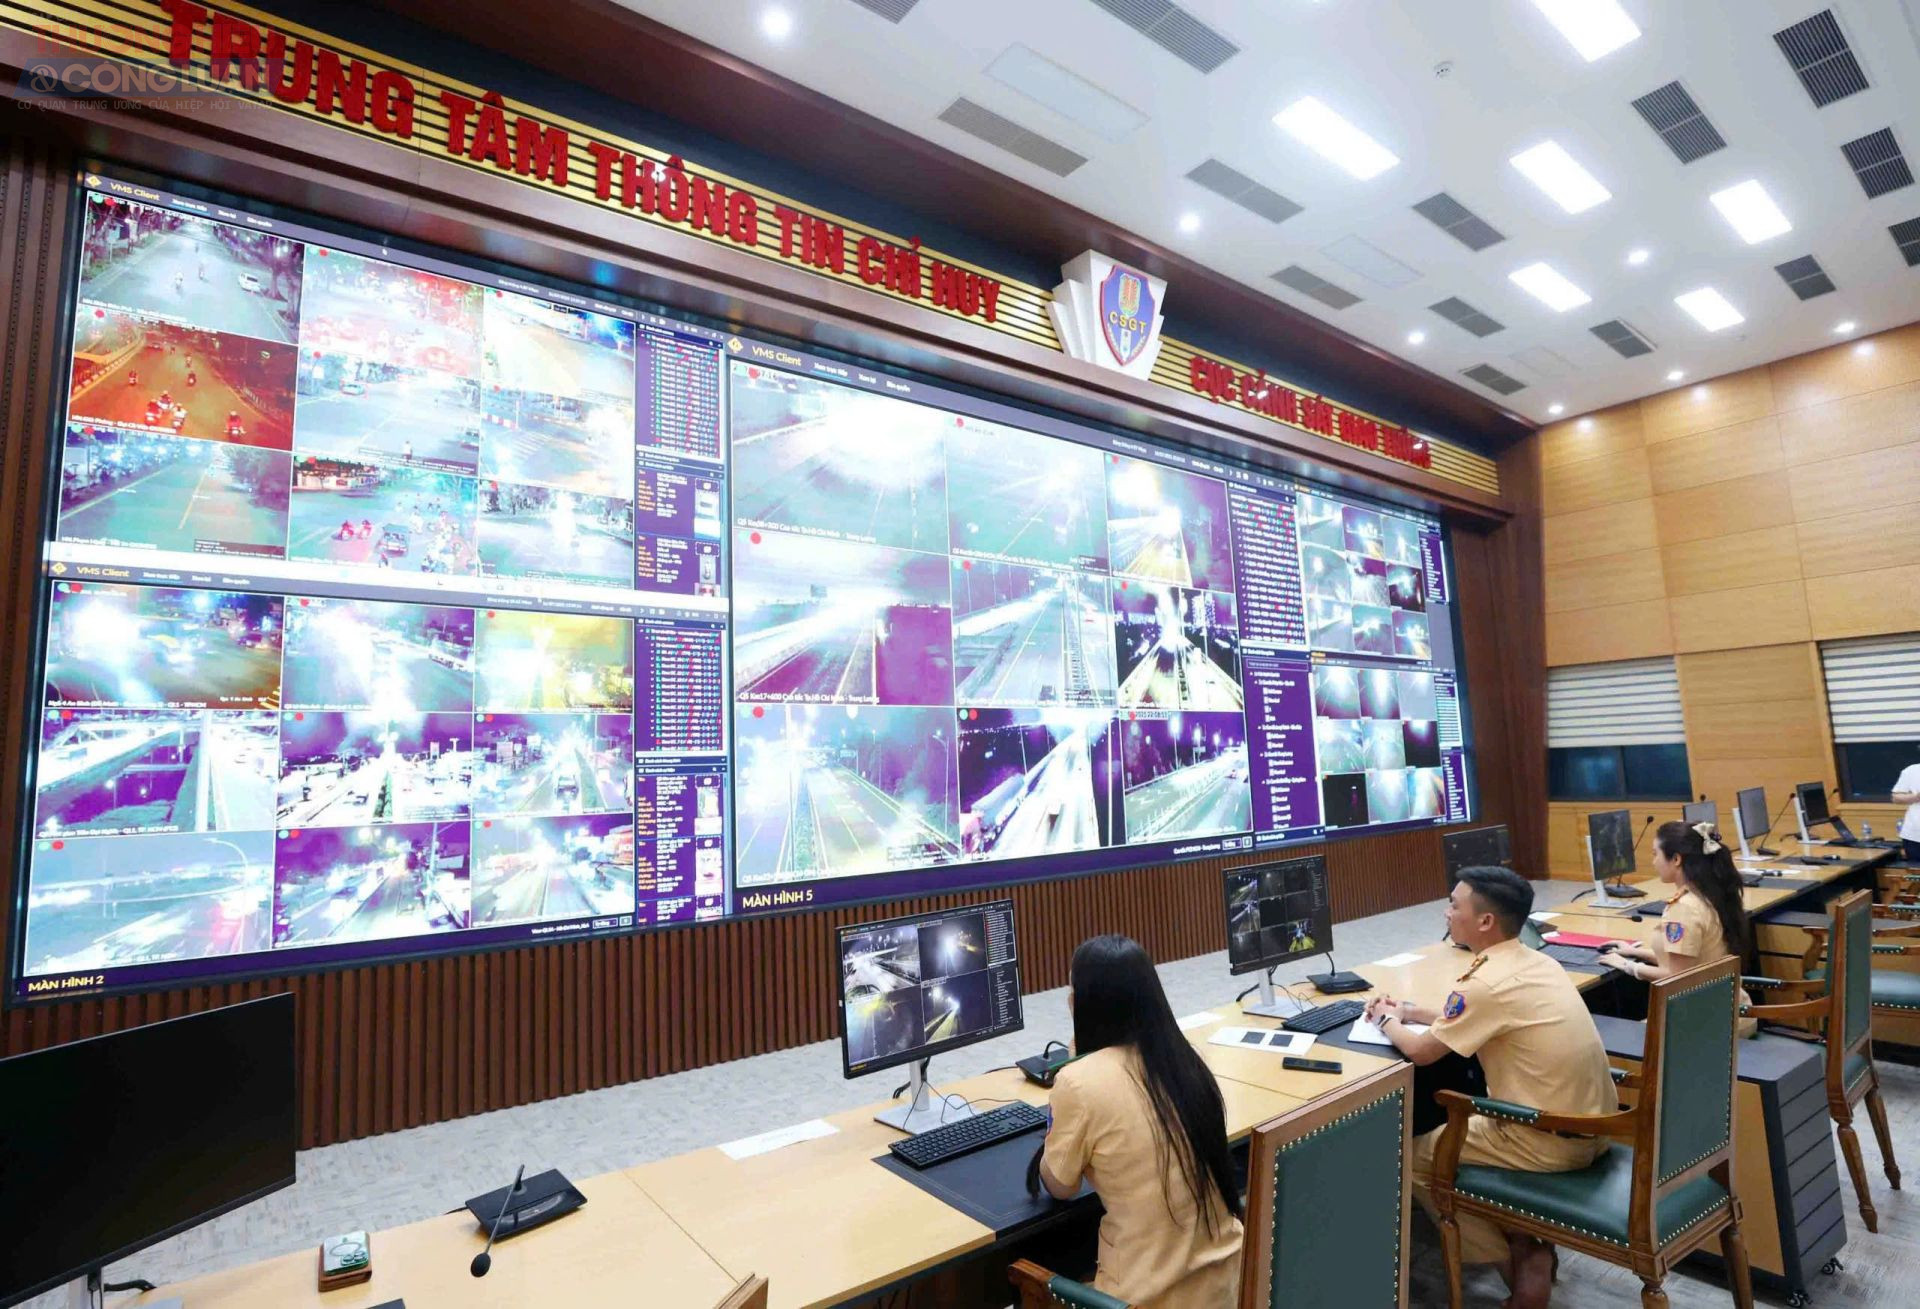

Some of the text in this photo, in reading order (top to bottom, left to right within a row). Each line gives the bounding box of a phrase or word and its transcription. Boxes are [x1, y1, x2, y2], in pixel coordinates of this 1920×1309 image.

[160, 0, 1001, 323] TRUNG TÂM THÔNG TIN CHỈ HUY
[110, 181, 160, 201] VMS Client
[1109, 311, 1147, 335] CSGT
[752, 346, 802, 366] VMS Client
[76, 566, 130, 577] VMS Client
[742, 889, 814, 909] MÀN HÌNH 5
[27, 975, 104, 992] MÀN HÌNH 2
